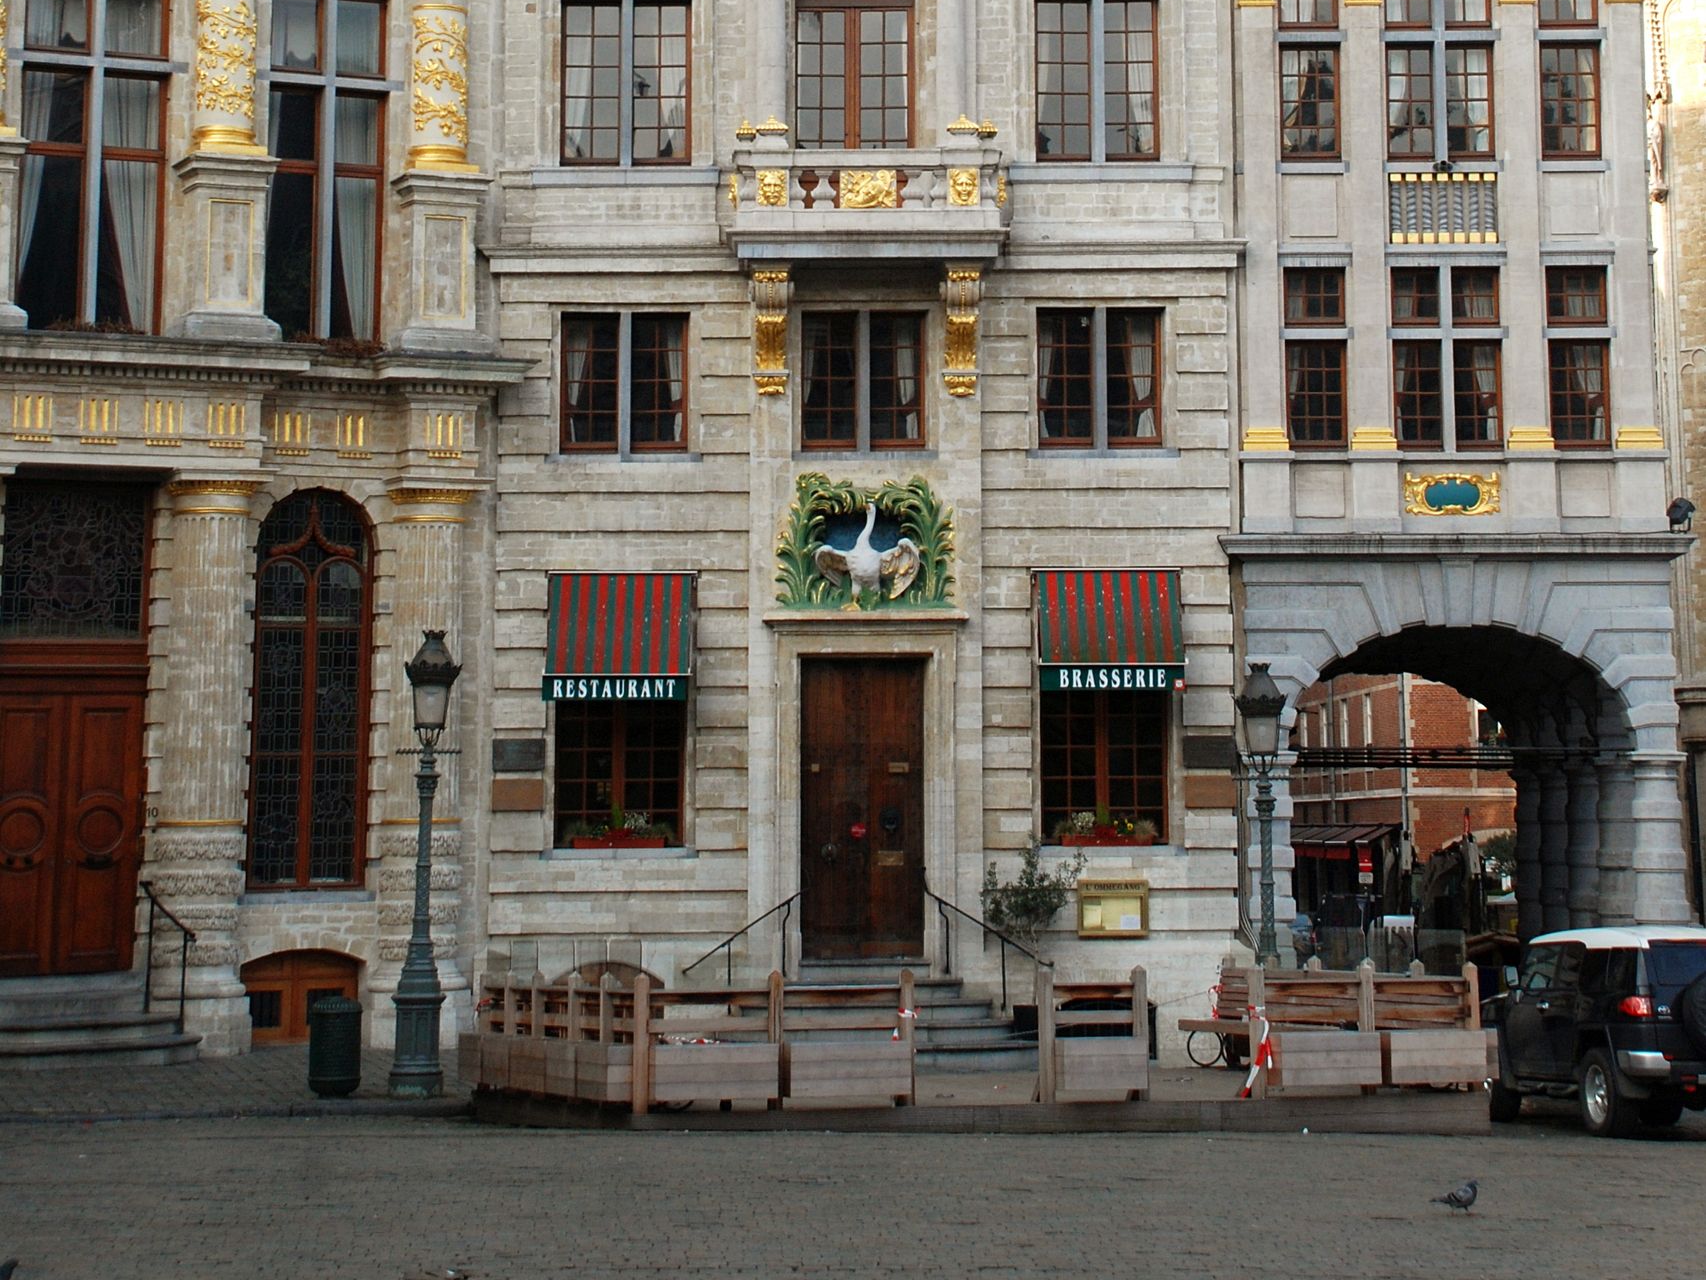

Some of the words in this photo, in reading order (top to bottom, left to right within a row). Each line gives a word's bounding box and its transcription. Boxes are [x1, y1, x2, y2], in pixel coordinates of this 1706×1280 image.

[1059, 669, 1166, 688] BRASSERIE
[553, 679, 676, 698] RESTAURANT
[147, 806, 159, 818] 10
